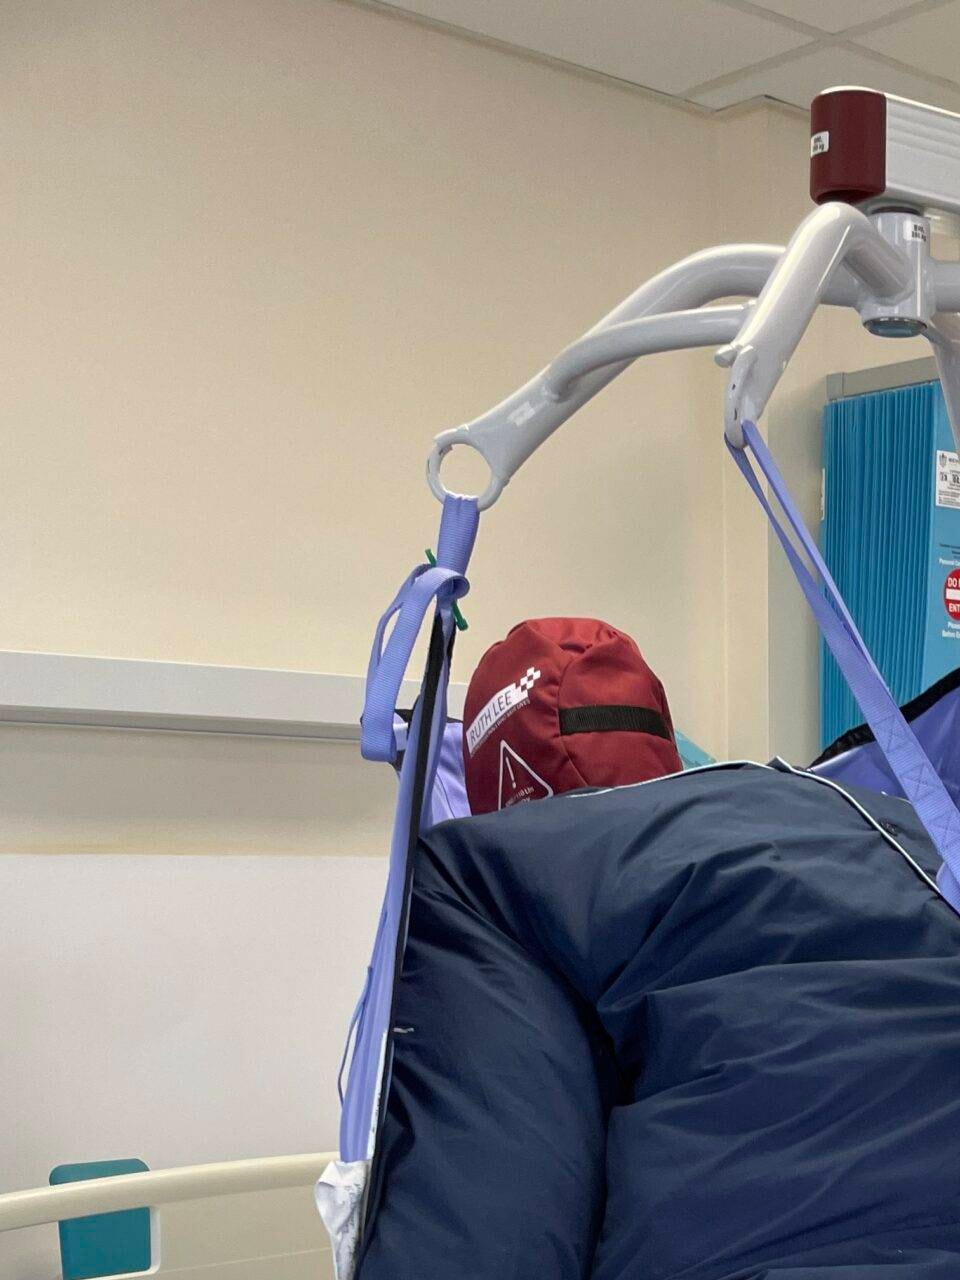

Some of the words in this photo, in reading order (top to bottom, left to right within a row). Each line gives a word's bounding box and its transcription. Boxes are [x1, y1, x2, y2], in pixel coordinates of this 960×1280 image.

[947, 577, 958, 588] DO
[469, 707, 492, 746] RUTH
[493, 690, 512, 717] LEE
